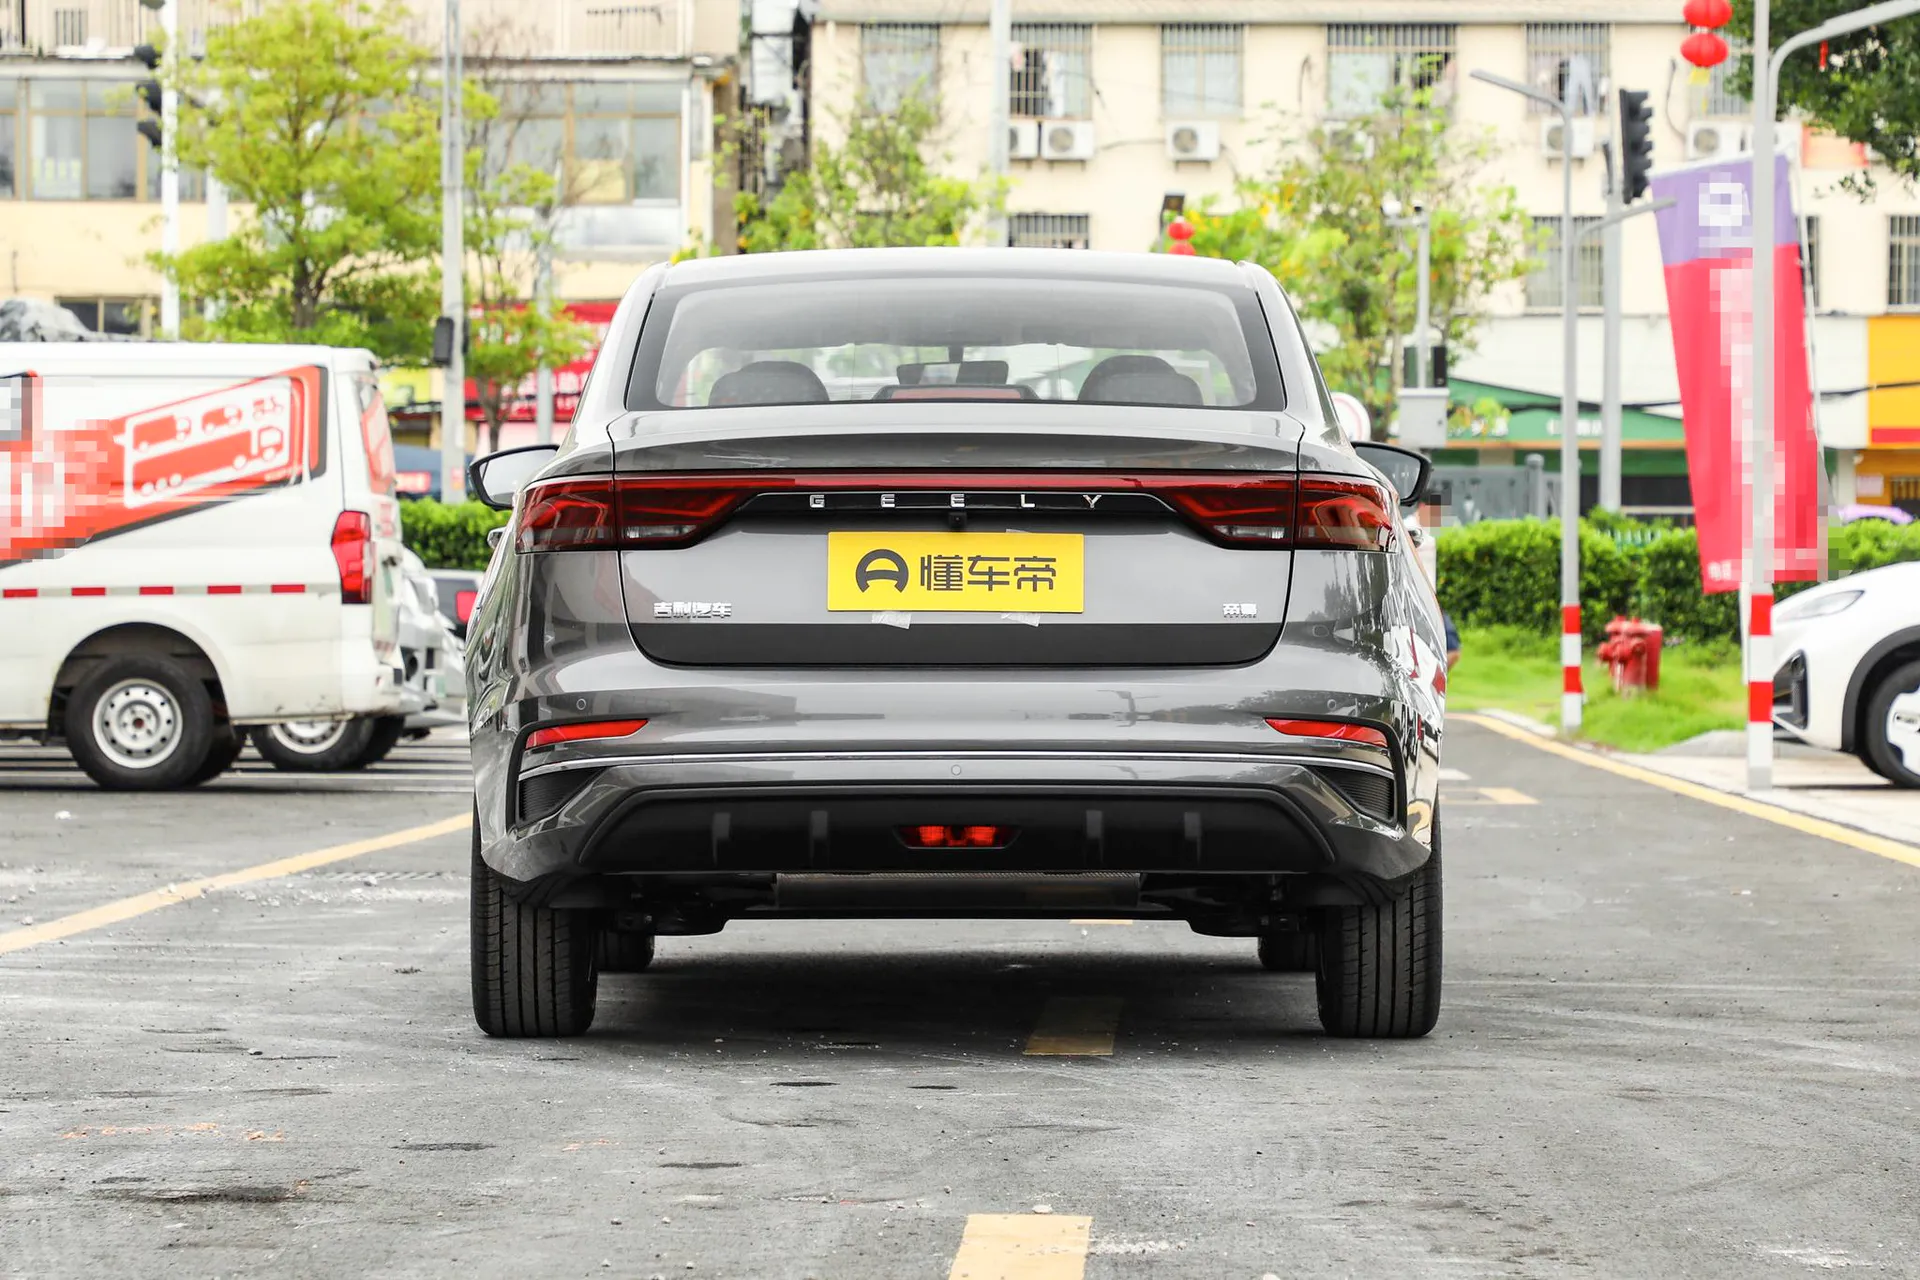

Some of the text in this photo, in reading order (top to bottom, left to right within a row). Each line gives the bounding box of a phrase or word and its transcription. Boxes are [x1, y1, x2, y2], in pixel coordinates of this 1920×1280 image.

[809, 494, 1102, 509] GEELY
[920, 554, 1057, 592] 懂车帝
[653, 601, 732, 618] 吉利汽车
